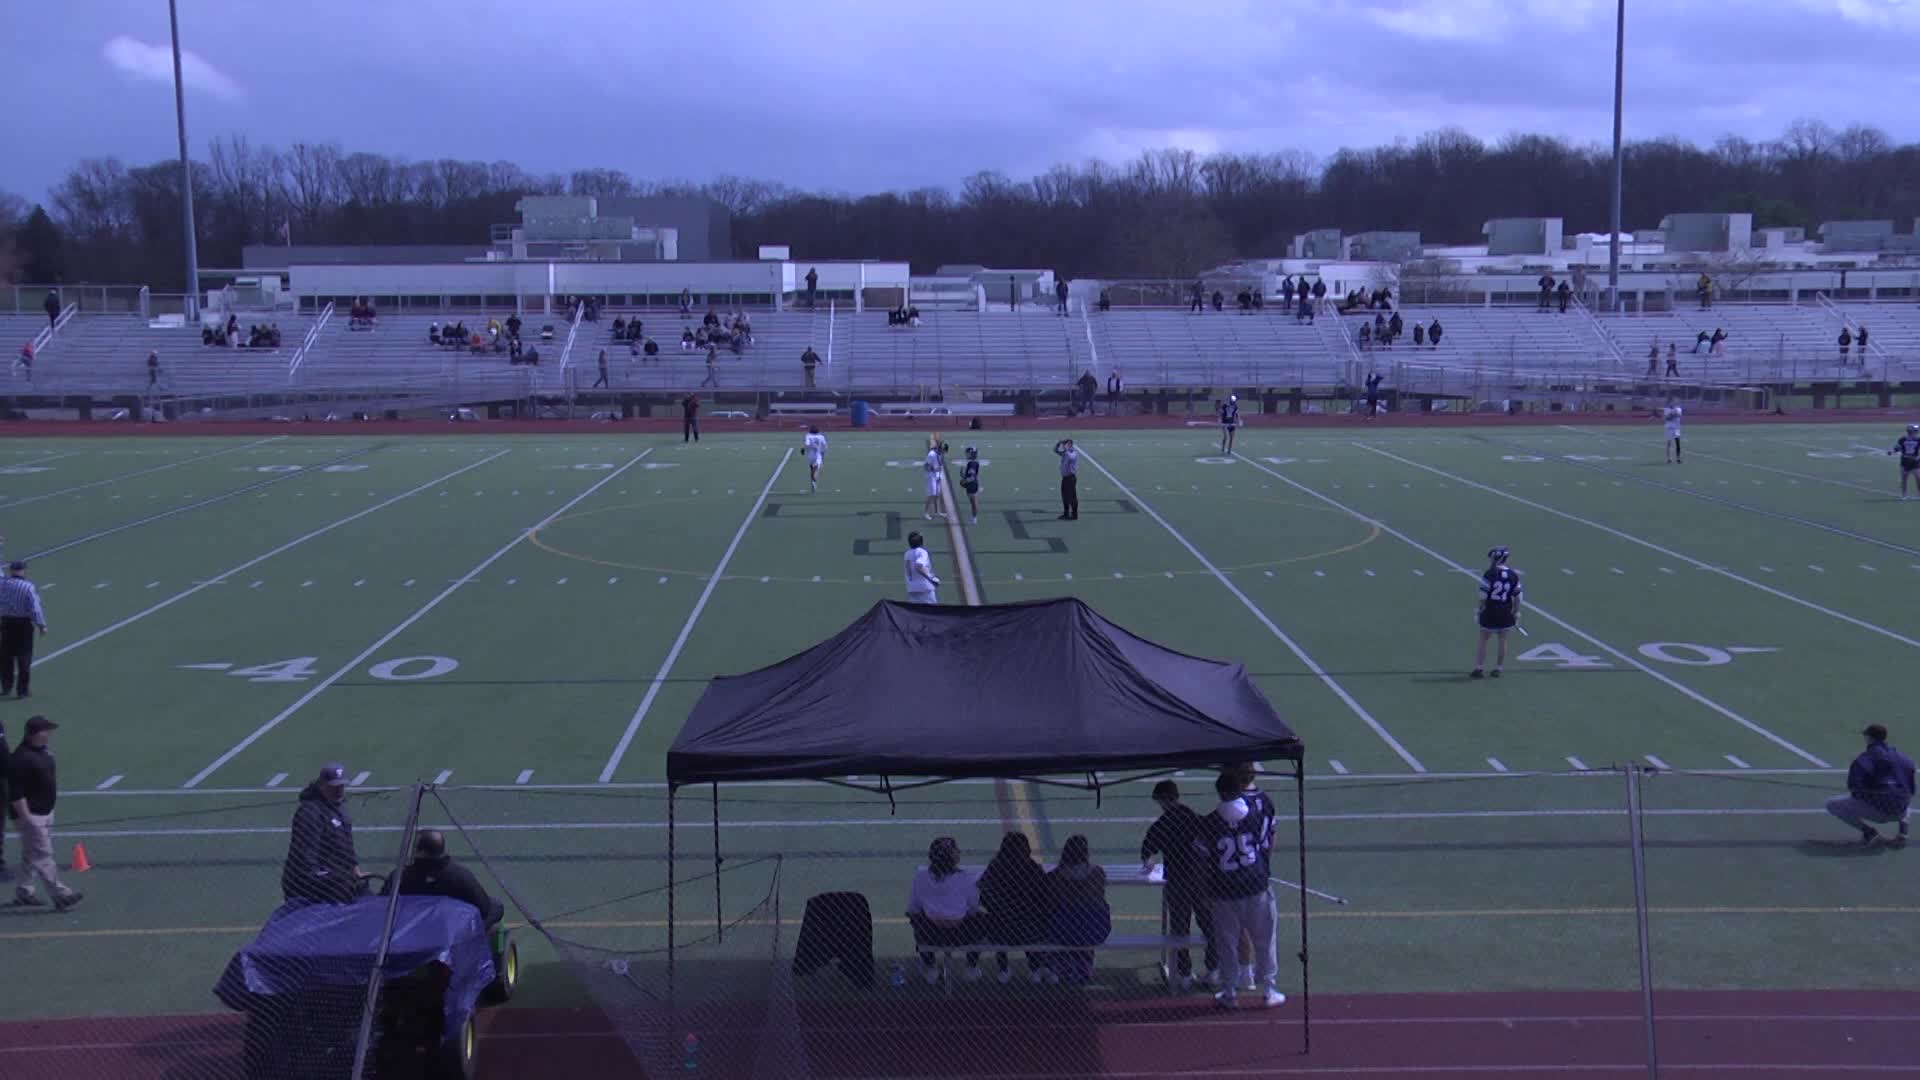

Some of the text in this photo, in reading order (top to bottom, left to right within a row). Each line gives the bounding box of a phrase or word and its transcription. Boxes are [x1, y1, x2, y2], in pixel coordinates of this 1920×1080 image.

[1490, 581, 1511, 602] 21
[1517, 642, 1733, 668] 40
[228, 656, 460, 683] 40
[1216, 831, 1256, 871] 25
